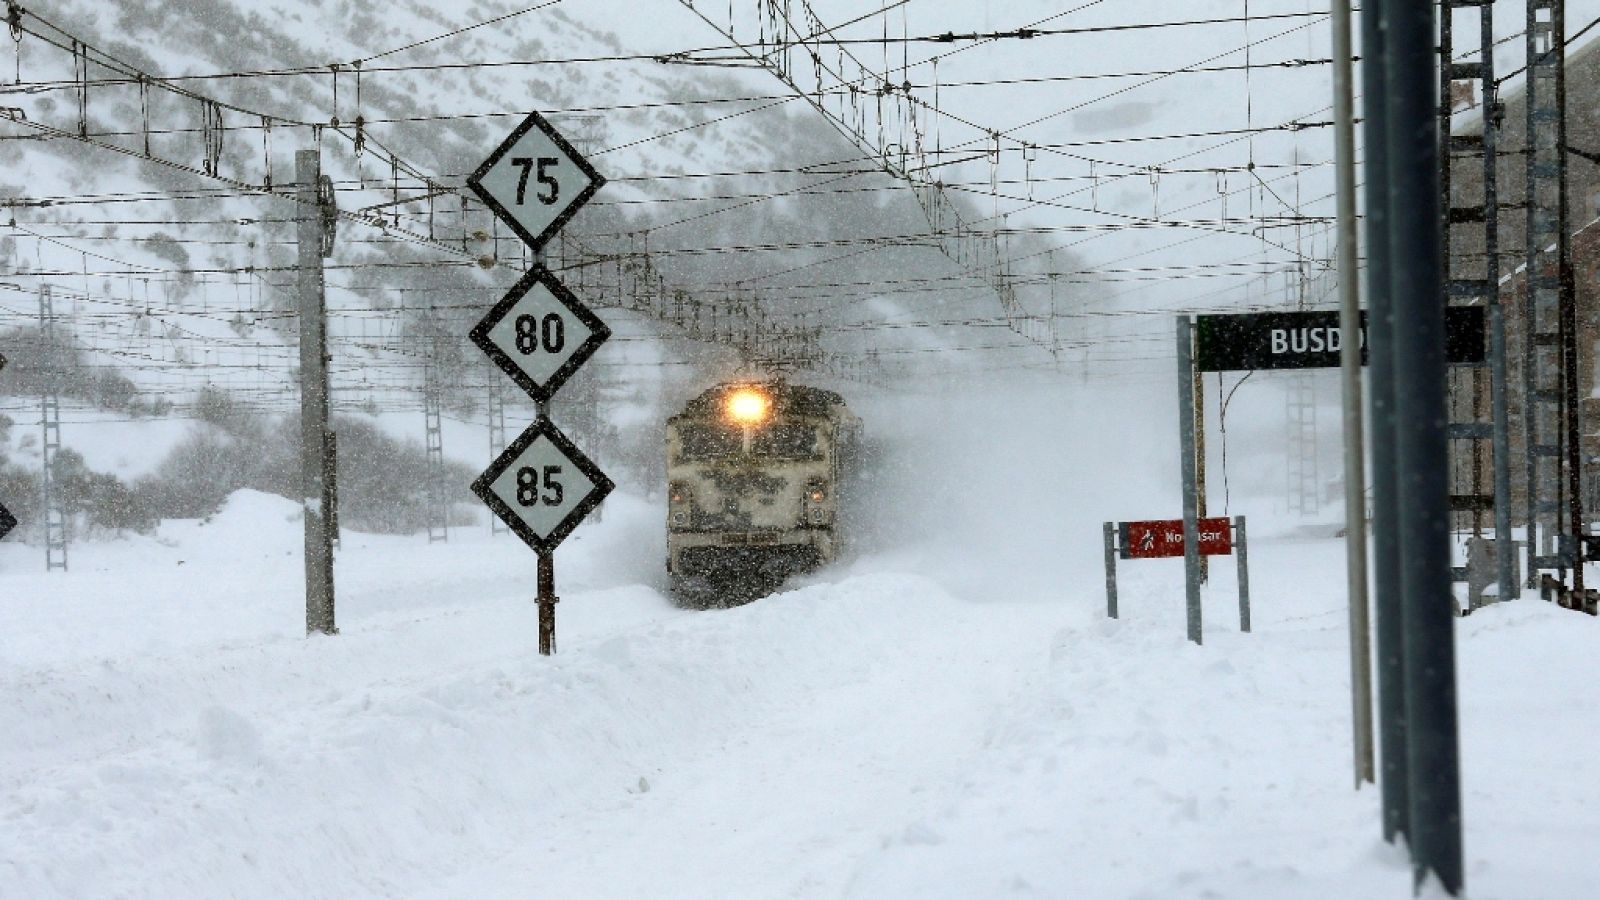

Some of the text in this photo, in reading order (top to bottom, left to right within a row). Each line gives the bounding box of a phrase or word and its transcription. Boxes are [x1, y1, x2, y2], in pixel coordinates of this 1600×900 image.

[511, 157, 559, 206] 75
[515, 313, 565, 356] 80
[1271, 327, 1364, 354] BUSD
[516, 465, 564, 507] 85
